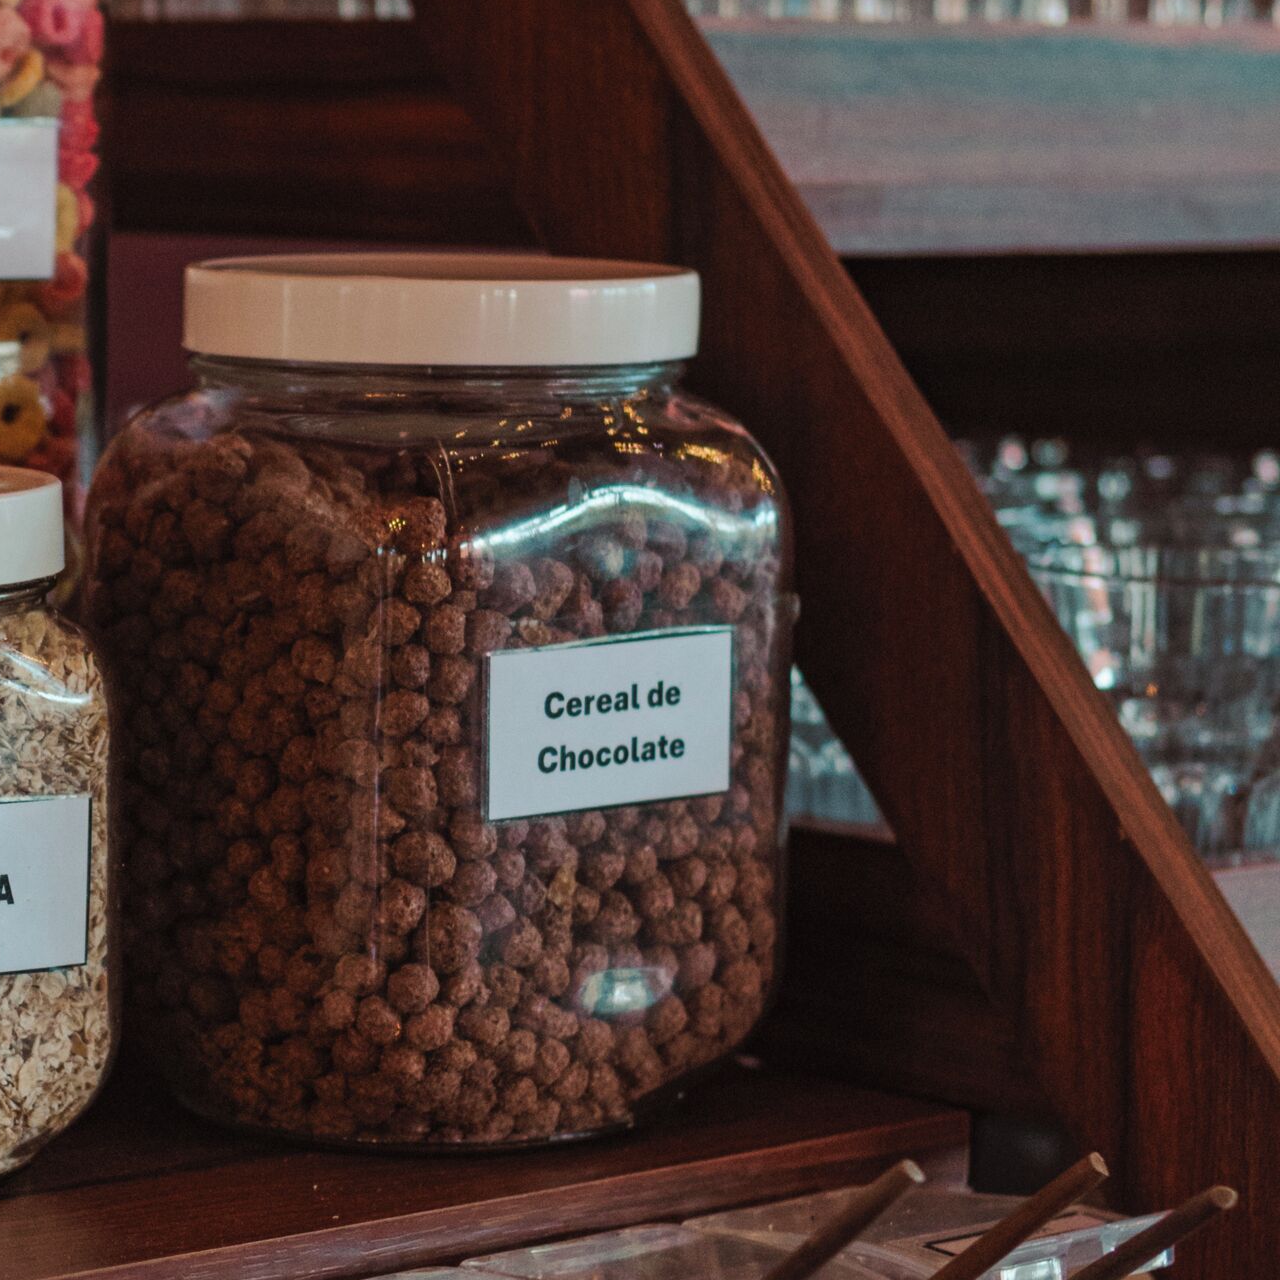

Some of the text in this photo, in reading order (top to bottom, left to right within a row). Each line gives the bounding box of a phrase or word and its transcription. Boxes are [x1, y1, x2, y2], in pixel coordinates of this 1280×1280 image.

[544, 680, 682, 719] Cereal de
[537, 735, 685, 774] Chocolate
